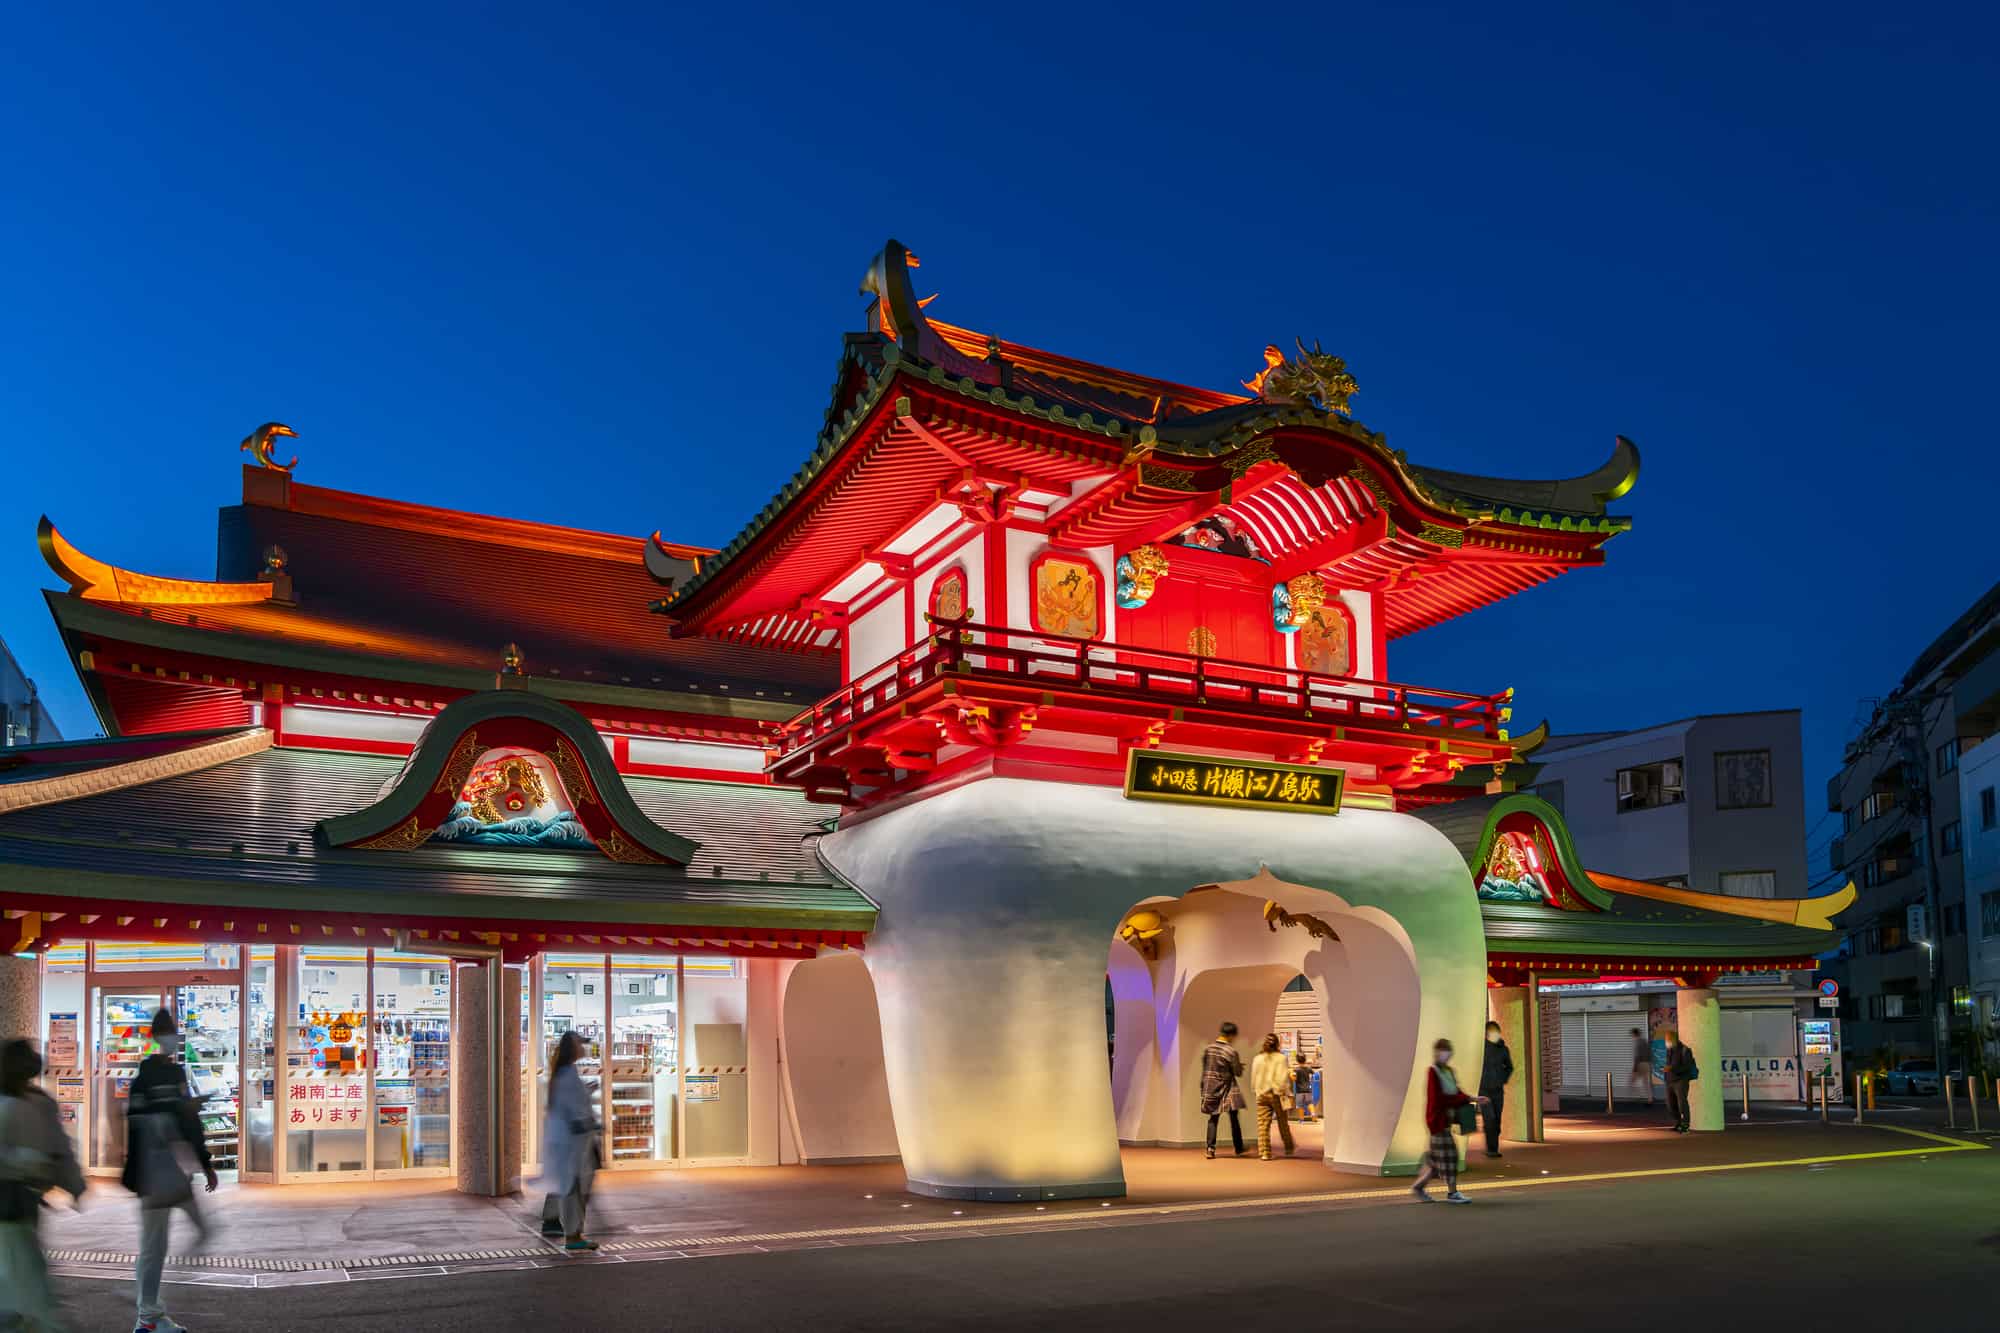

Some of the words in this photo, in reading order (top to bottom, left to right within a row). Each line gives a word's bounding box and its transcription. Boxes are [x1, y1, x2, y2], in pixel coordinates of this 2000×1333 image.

[1152, 766, 1198, 791] 小田急
[290, 1084, 363, 1100] 湘南土産
[290, 1107, 362, 1123] あります
